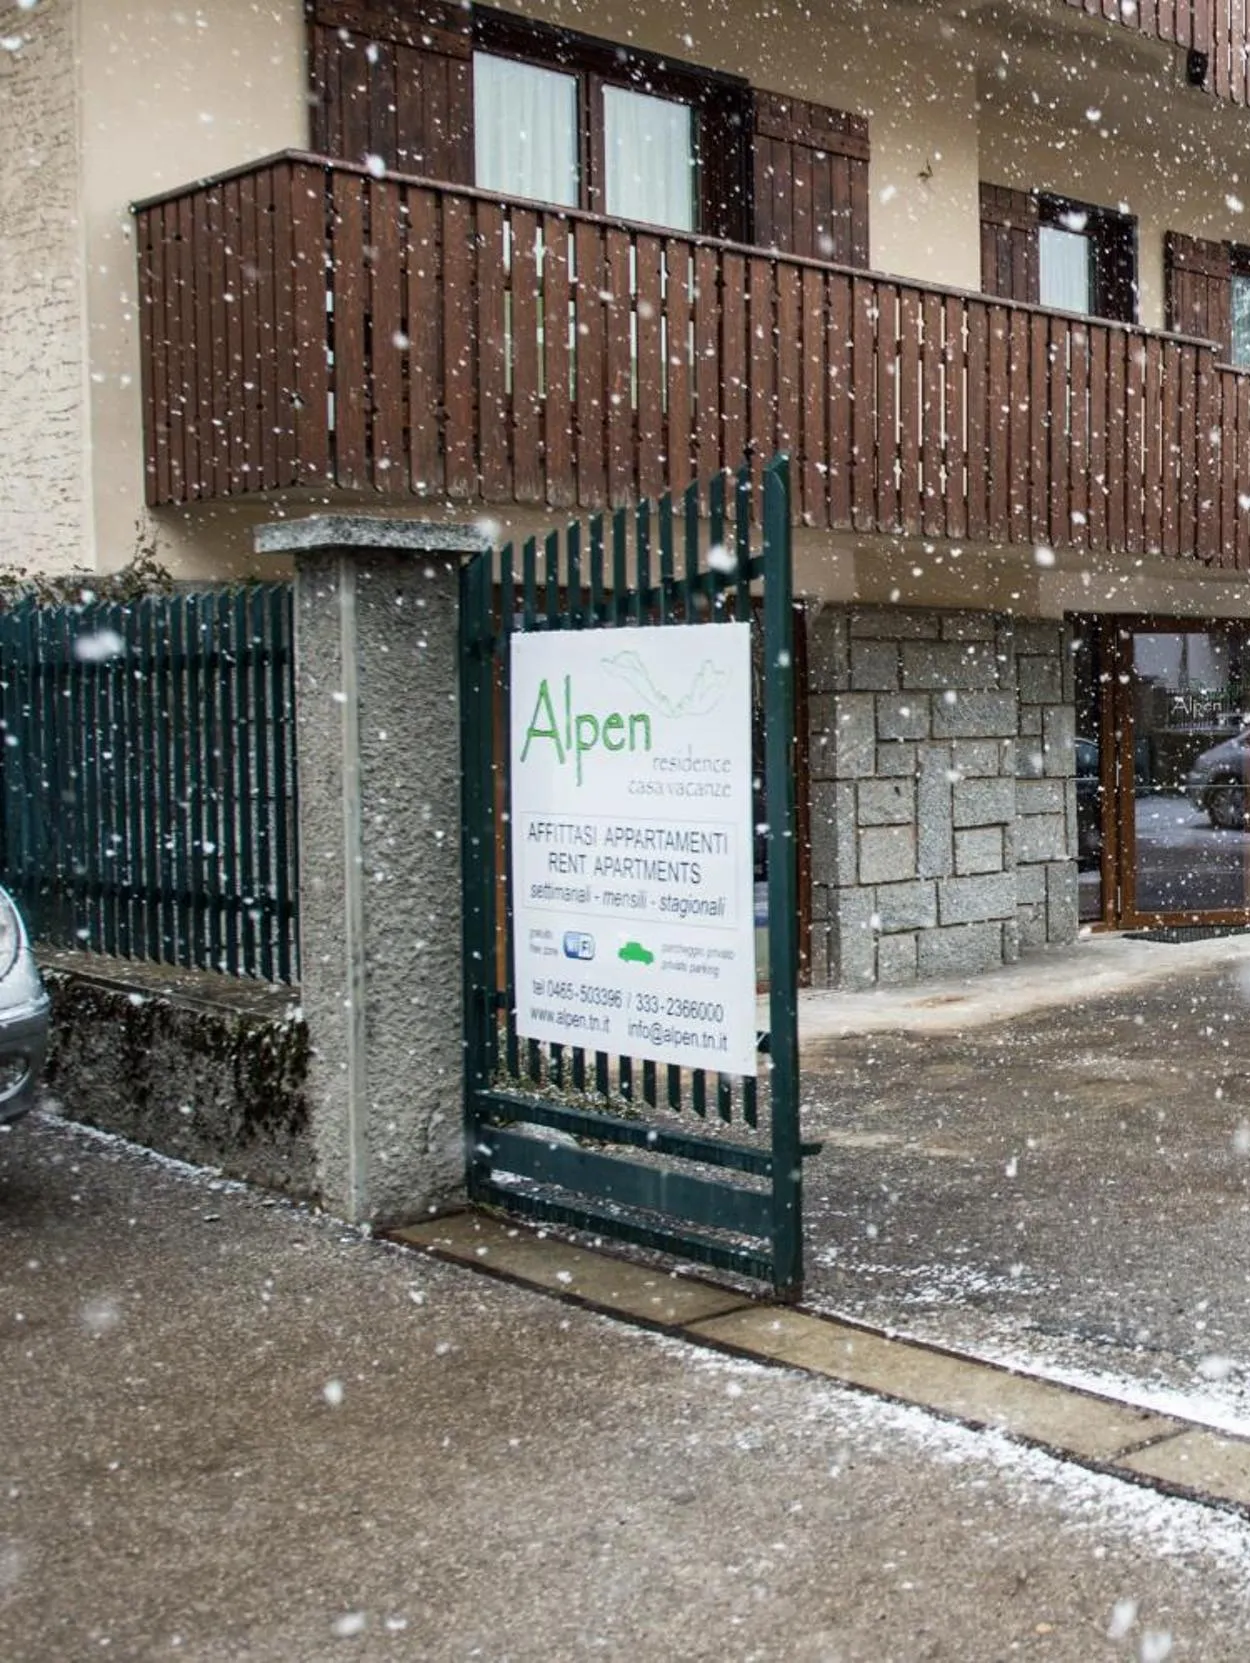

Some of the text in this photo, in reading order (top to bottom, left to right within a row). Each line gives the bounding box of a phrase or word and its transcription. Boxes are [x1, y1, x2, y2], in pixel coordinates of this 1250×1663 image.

[1170, 695, 1222, 719] Alpen
[520, 675, 652, 787] Alpen
[653, 744, 732, 773] residence
[527, 822, 729, 854] AFFITTASI APPARTAMENTI
[548, 852, 702, 885] RENT APARTMENTS
[530, 882, 592, 904] settimanali
[602, 889, 648, 909] mensili
[660, 894, 726, 919] stagionali
[627, 1018, 728, 1052] info@alpen.tn.it
